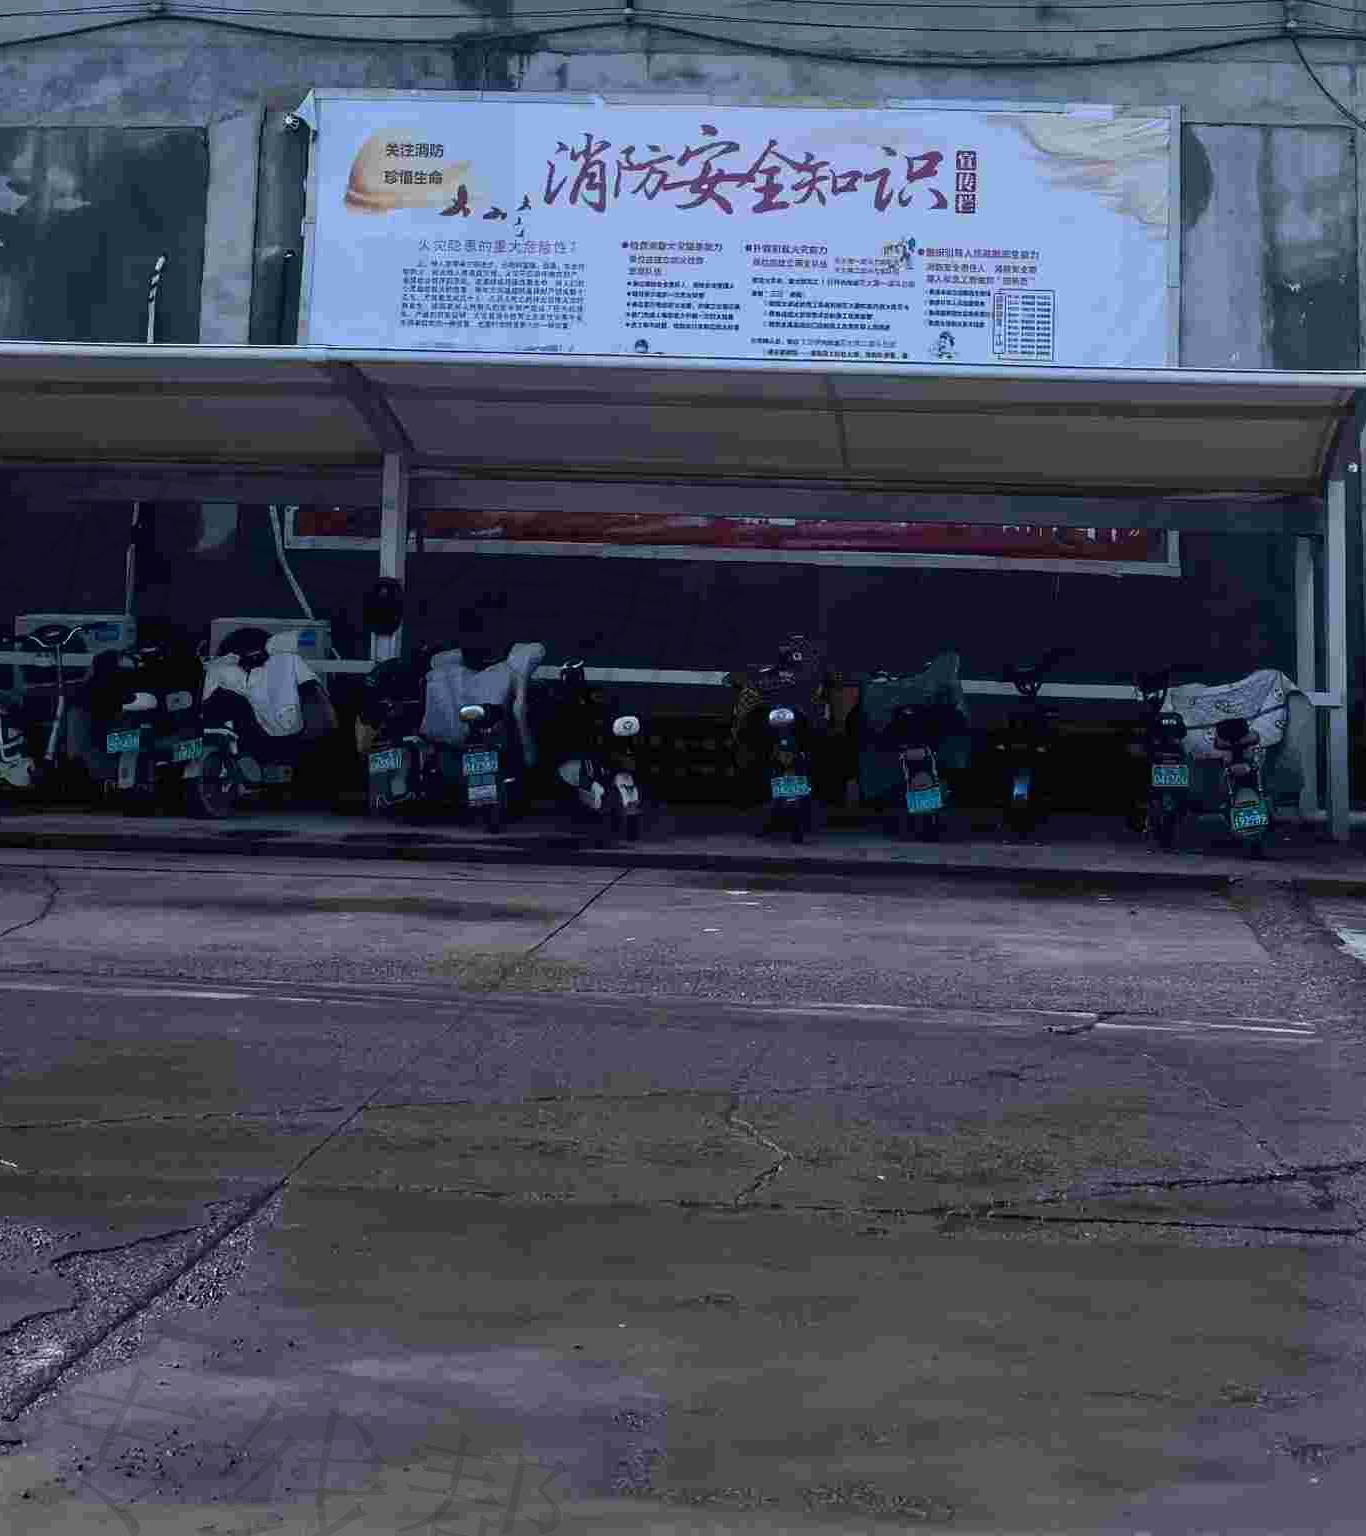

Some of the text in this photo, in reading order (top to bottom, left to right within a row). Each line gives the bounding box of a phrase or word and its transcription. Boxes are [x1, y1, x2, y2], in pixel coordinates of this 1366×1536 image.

[385, 143, 444, 159] 关注消防
[384, 170, 444, 185] 珍惜生命
[544, 125, 950, 215] 消防安全知识
